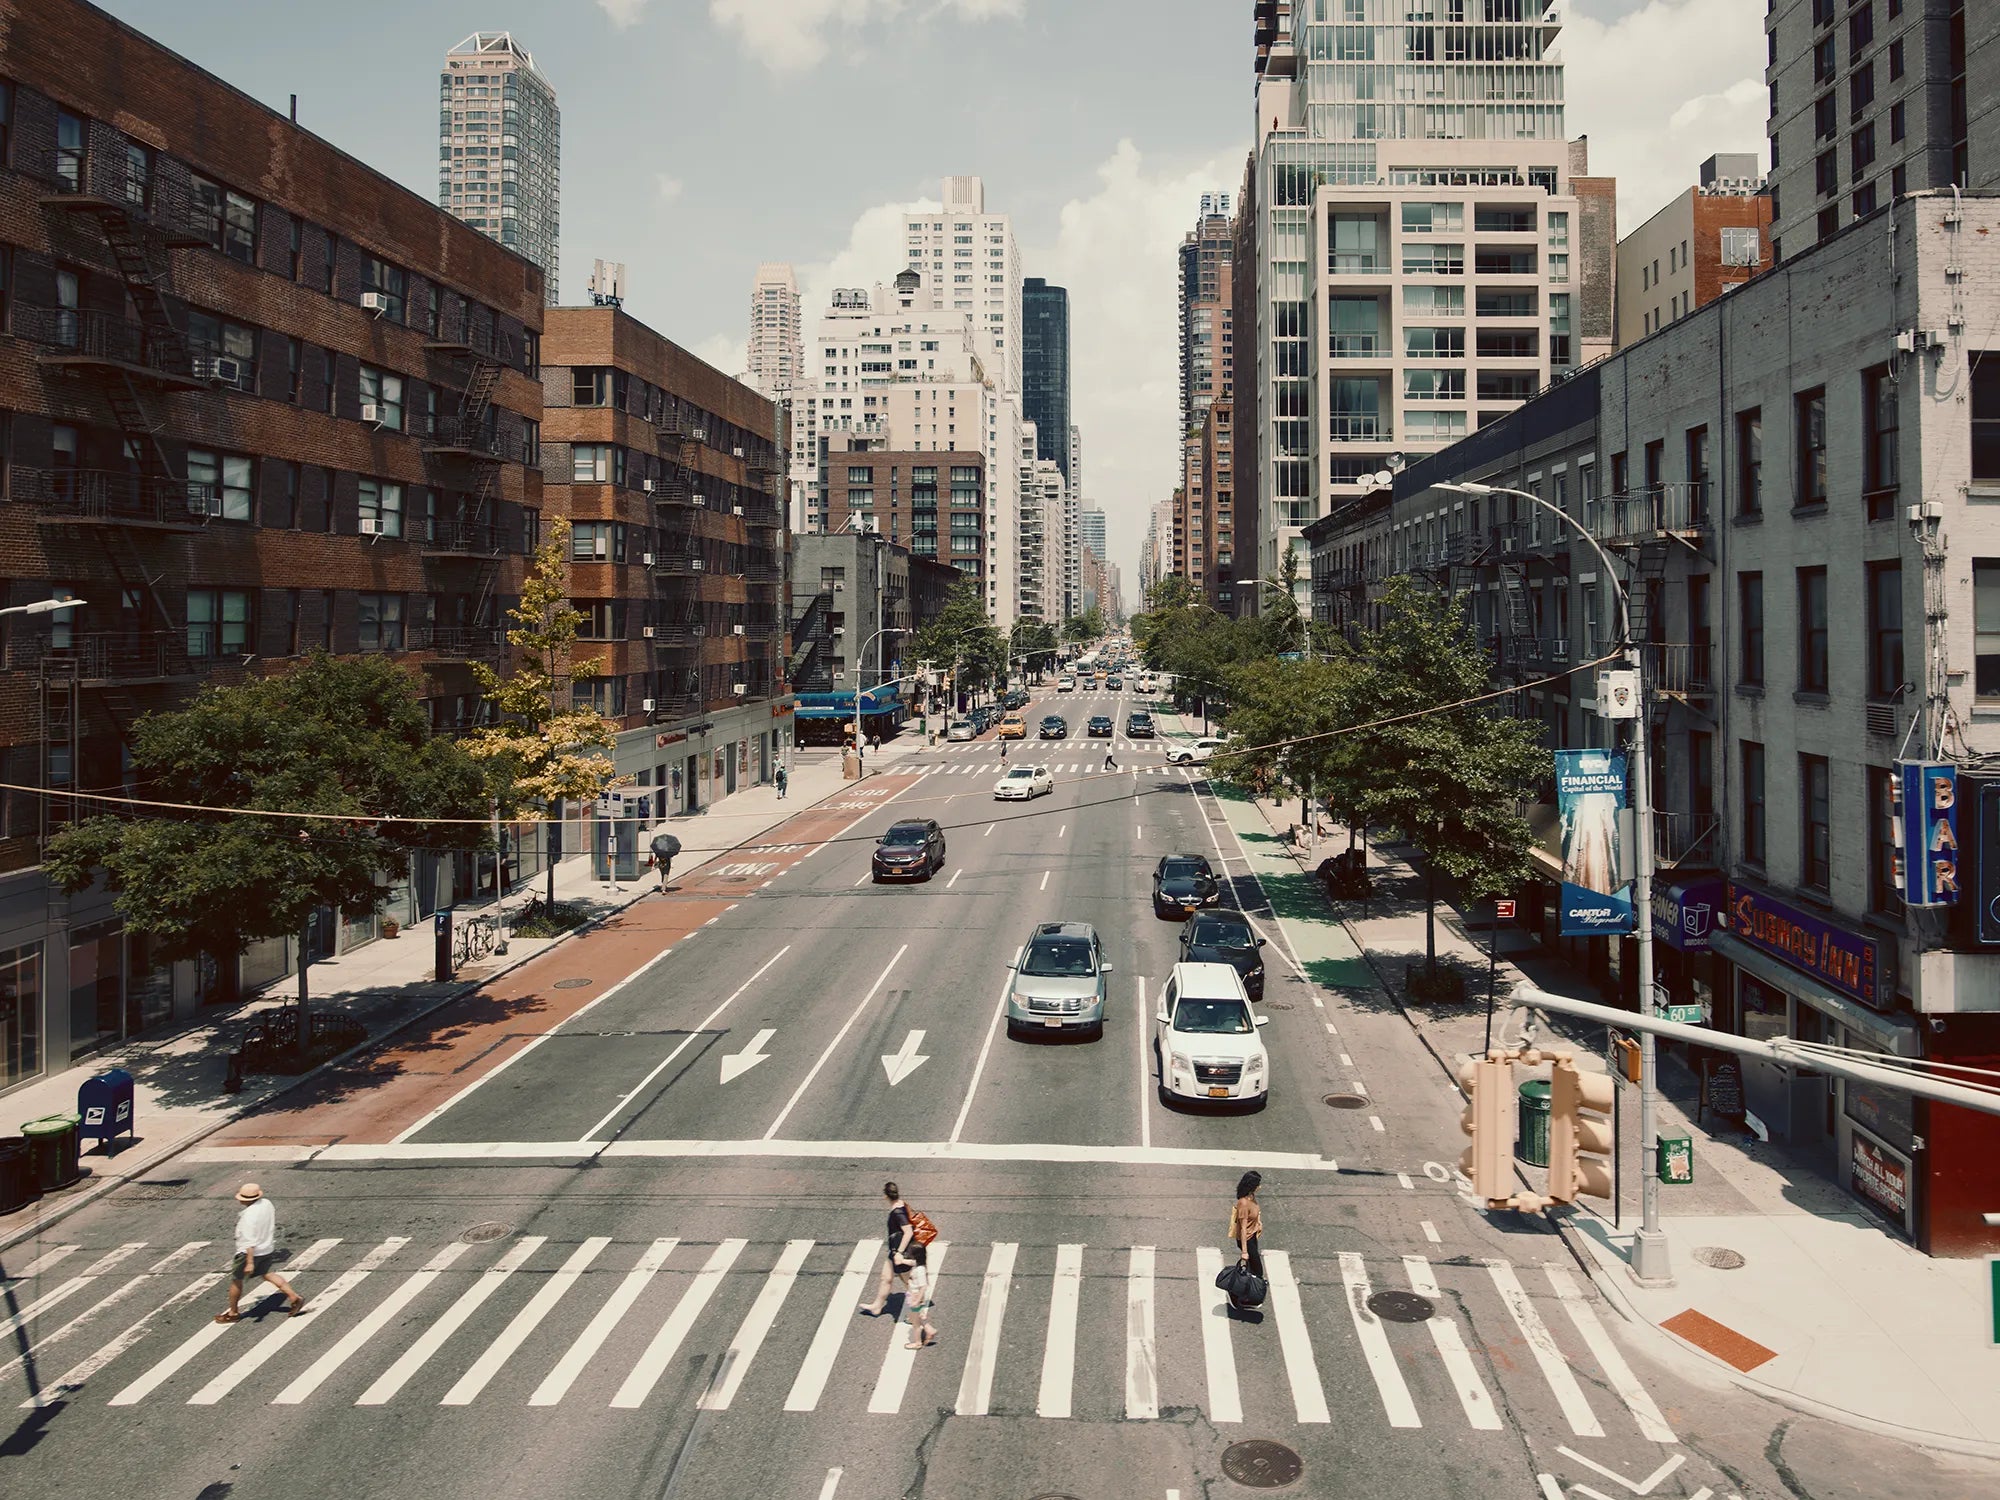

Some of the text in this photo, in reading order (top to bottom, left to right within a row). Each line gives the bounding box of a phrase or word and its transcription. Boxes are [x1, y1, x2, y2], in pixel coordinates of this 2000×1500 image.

[1561, 775, 1623, 786] FINANCIAL
[850, 789, 889, 797] BUS
[1562, 785, 1584, 793] Capital
[1930, 776, 1960, 893] BAR
[1569, 908, 1611, 917] CANTOR
[1581, 913, 1628, 927] Fitzgerald
[1670, 1007, 1686, 1022] 60
[1687, 1007, 1696, 1016] ST
[1874, 1162, 1885, 1180] ALL
[1885, 1169, 1904, 1193] YOUR
